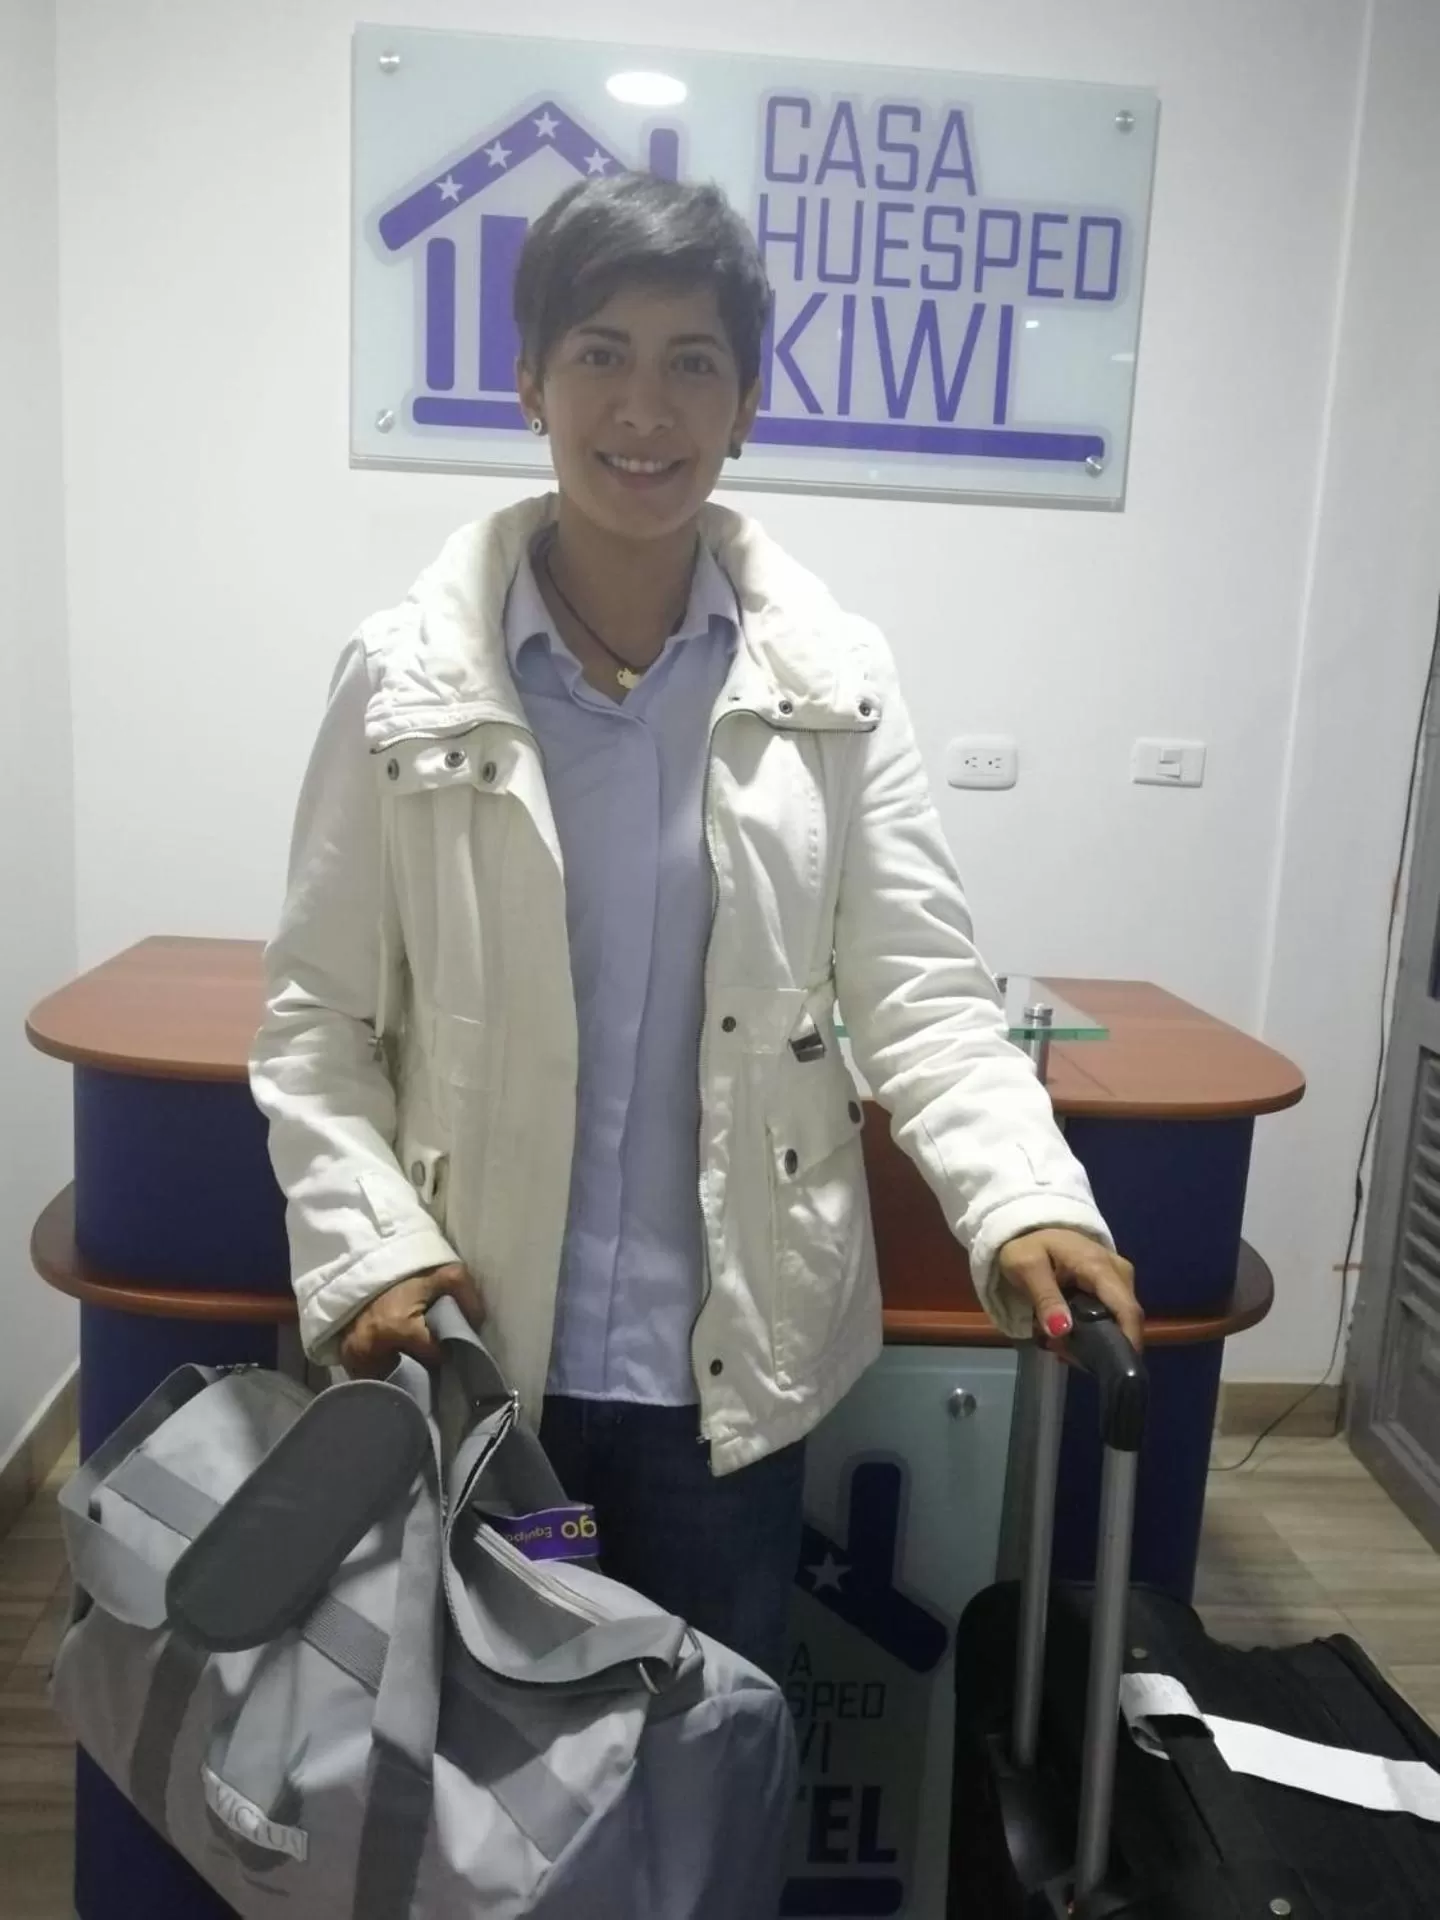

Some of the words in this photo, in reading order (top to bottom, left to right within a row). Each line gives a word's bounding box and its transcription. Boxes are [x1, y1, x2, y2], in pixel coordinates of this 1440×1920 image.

[764, 96, 976, 196] CASA
[758, 193, 1122, 301] HUESPED
[759, 290, 1014, 425] KIWI
[786, 1681, 886, 1719] SPED
[797, 1785, 897, 1864] EL
